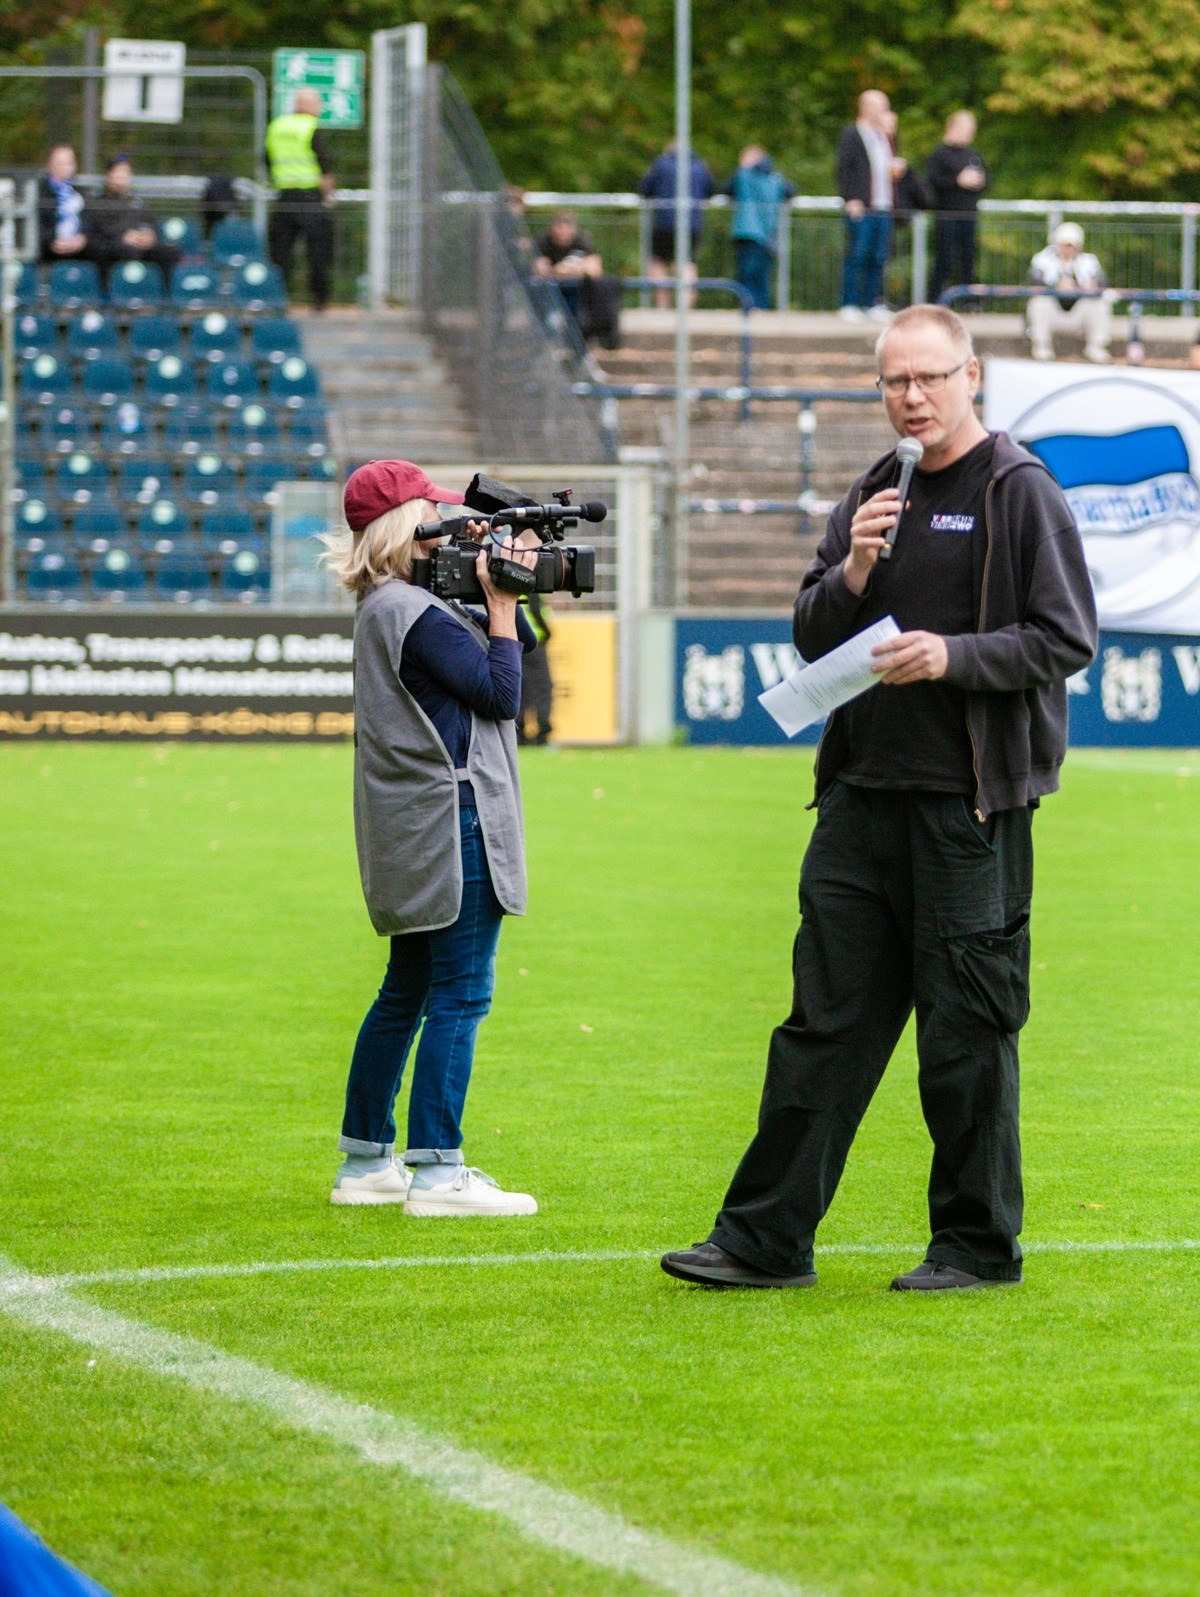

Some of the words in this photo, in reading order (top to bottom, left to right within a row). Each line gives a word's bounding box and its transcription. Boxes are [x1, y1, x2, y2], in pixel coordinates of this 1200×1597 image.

[510, 571, 530, 583] SONY
[86, 633, 254, 666] Transporter
[255, 634, 281, 663] &
